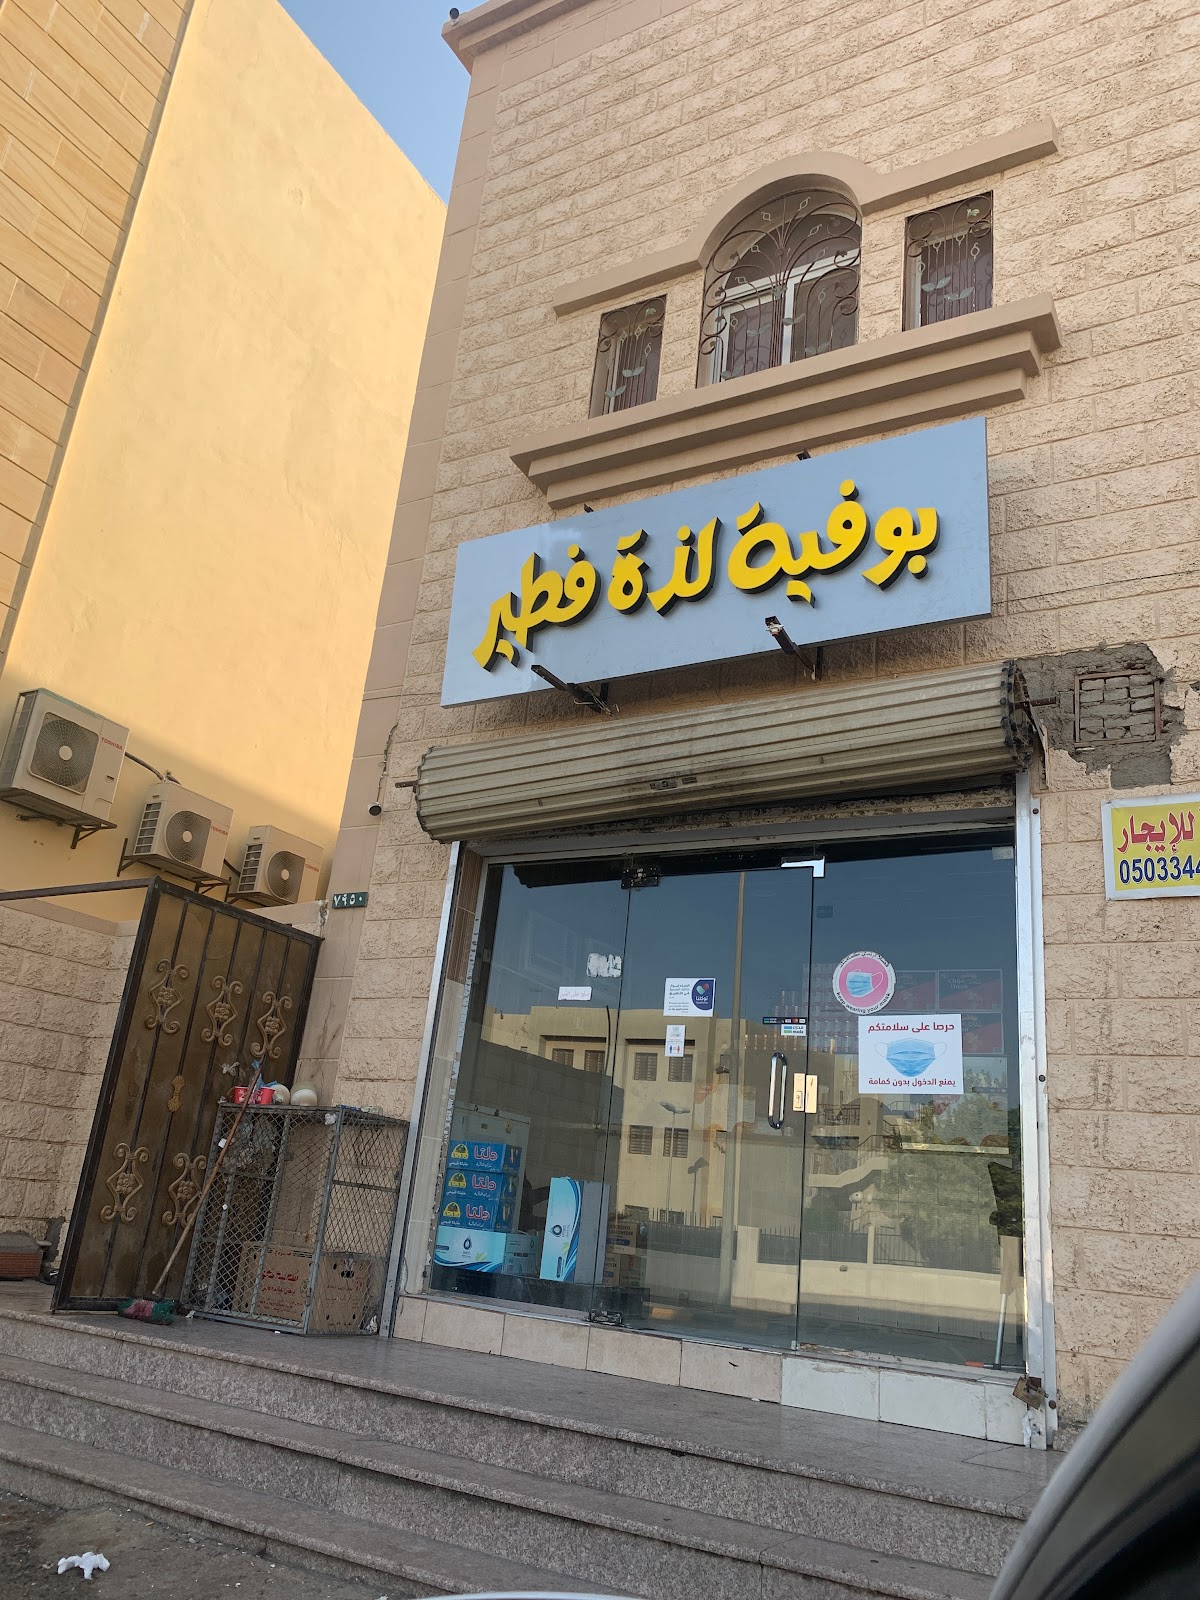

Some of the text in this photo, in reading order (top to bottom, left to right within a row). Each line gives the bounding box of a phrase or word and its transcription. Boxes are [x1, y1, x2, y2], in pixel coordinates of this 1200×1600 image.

[473, 480, 938, 667] بوفية لذة فطير
[101, 736, 123, 751] TOSHIBA
[1117, 811, 1195, 853] للإيجار
[334, 893, 363, 906] ٧٩٥٠
[868, 1023, 909, 1033] سلامتكم
[911, 1022, 930, 1033] على
[933, 1021, 955, 1033] حرصا
[868, 1078, 891, 1086] كمامة
[912, 1078, 937, 1087] الدخول
[938, 1079, 956, 1087] يمنع
[474, 1145, 498, 1161] دلتا
[472, 1174, 497, 1190] دلتا
[466, 1203, 490, 1220] دلتا
